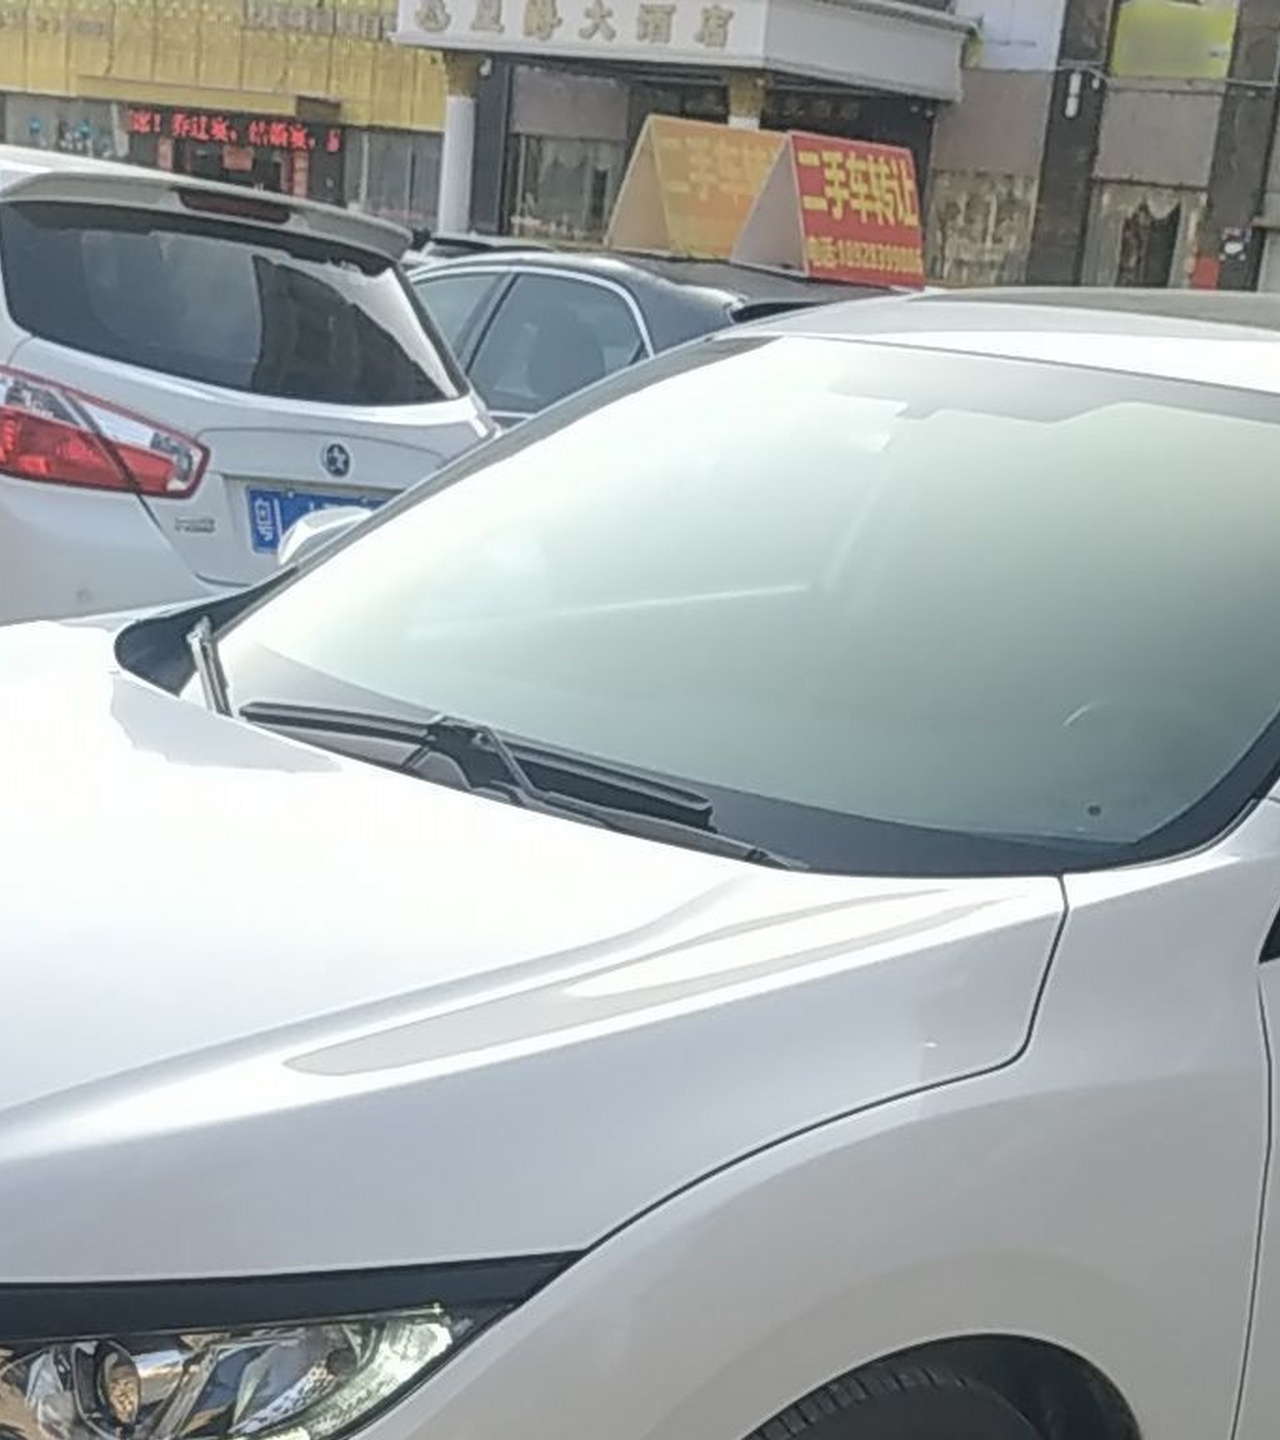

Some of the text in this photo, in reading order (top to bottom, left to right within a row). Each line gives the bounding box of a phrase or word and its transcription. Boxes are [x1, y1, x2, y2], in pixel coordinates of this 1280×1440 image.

[797, 150, 919, 227] 二手车转让
